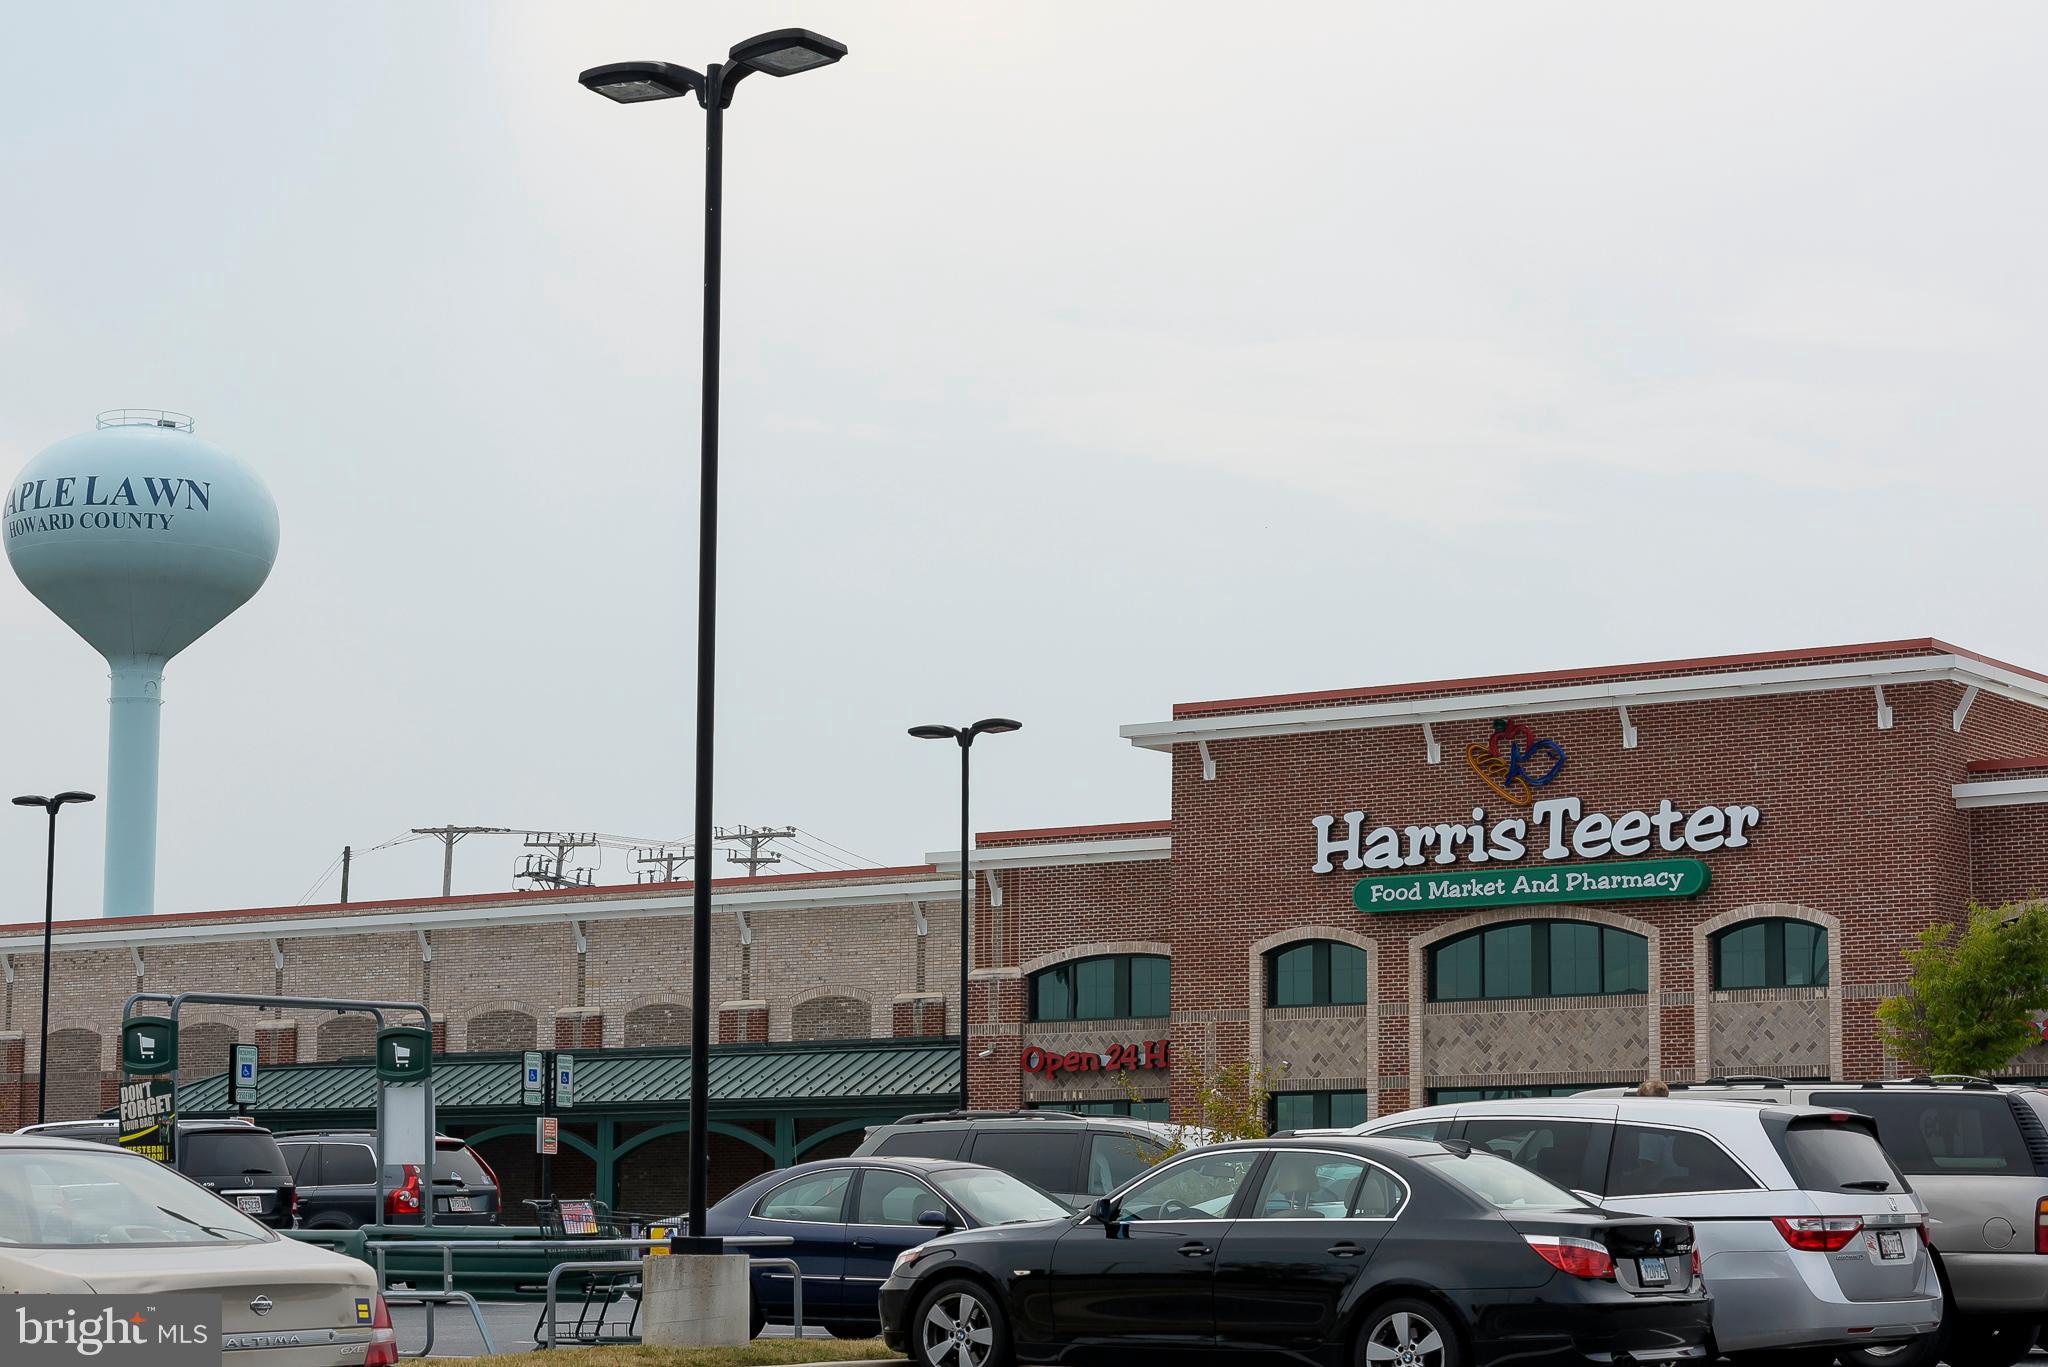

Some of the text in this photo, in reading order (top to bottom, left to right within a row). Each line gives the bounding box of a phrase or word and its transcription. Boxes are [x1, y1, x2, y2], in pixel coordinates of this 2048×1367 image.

[83, 475, 211, 512] LAWN
[9, 512, 174, 538] HOWARD COUNTY
[1311, 797, 1760, 873] Harris Teeter
[1370, 871, 1684, 902] Food Market And Pharmacy
[1021, 1039, 1170, 1081] Open 24 H
[121, 1082, 151, 1103] DON'T
[121, 1093, 171, 1120] FORGET
[122, 1119, 139, 1132] YOUR
[225, 1335, 301, 1348] ALTIMA
[340, 1345, 367, 1355] GXE
